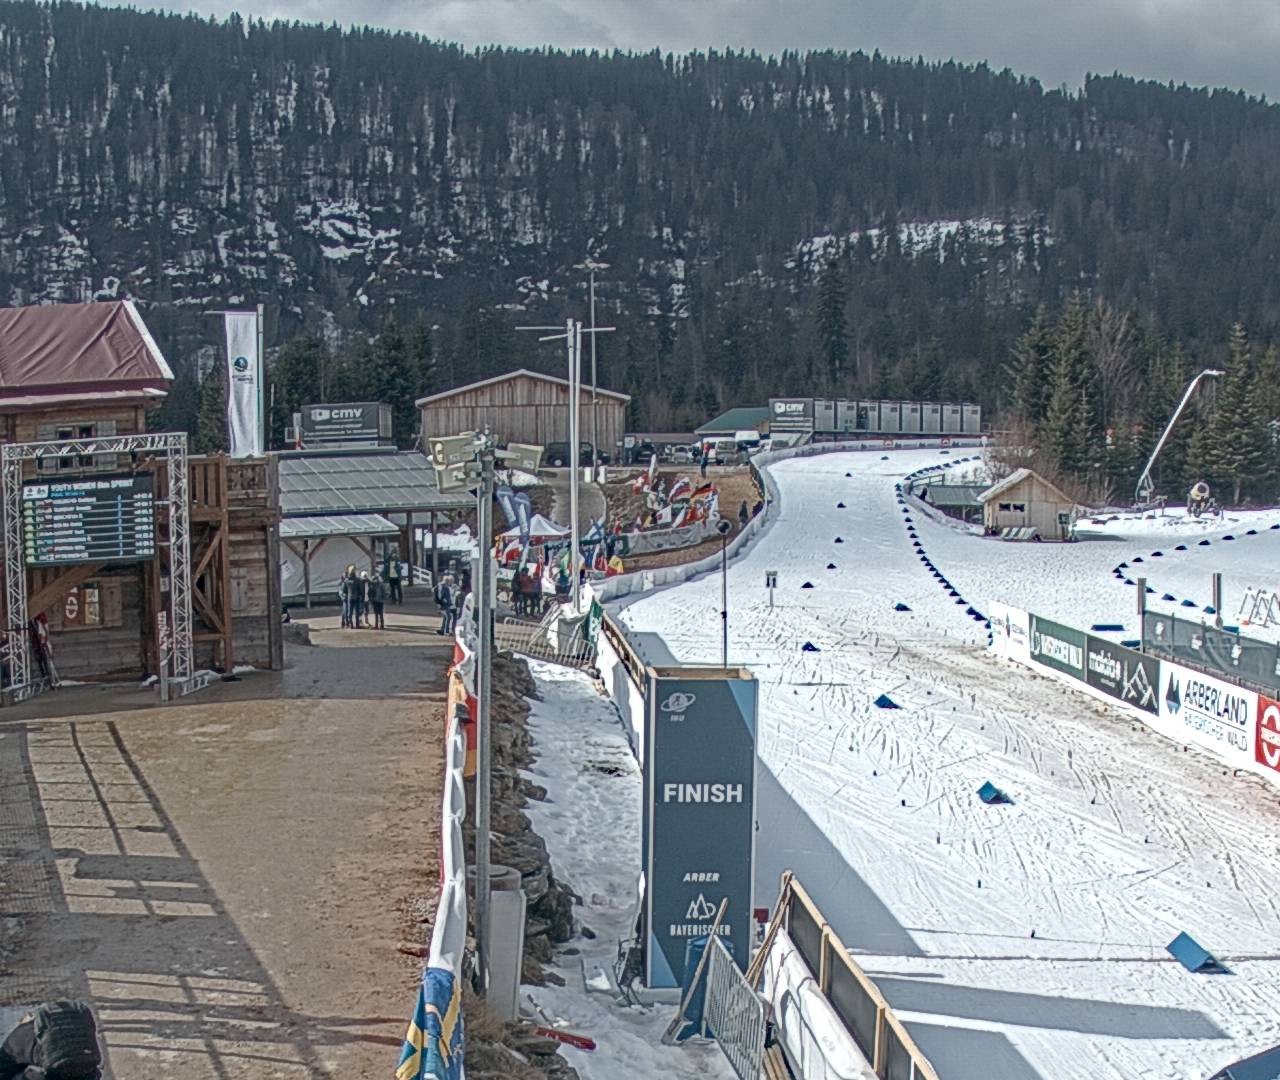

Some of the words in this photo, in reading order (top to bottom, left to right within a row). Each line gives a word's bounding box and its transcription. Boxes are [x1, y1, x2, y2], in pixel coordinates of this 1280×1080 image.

[1184, 679, 1248, 726] ARBERLAND
[663, 783, 743, 803] FINISH
[683, 872, 720, 882] ARBER
